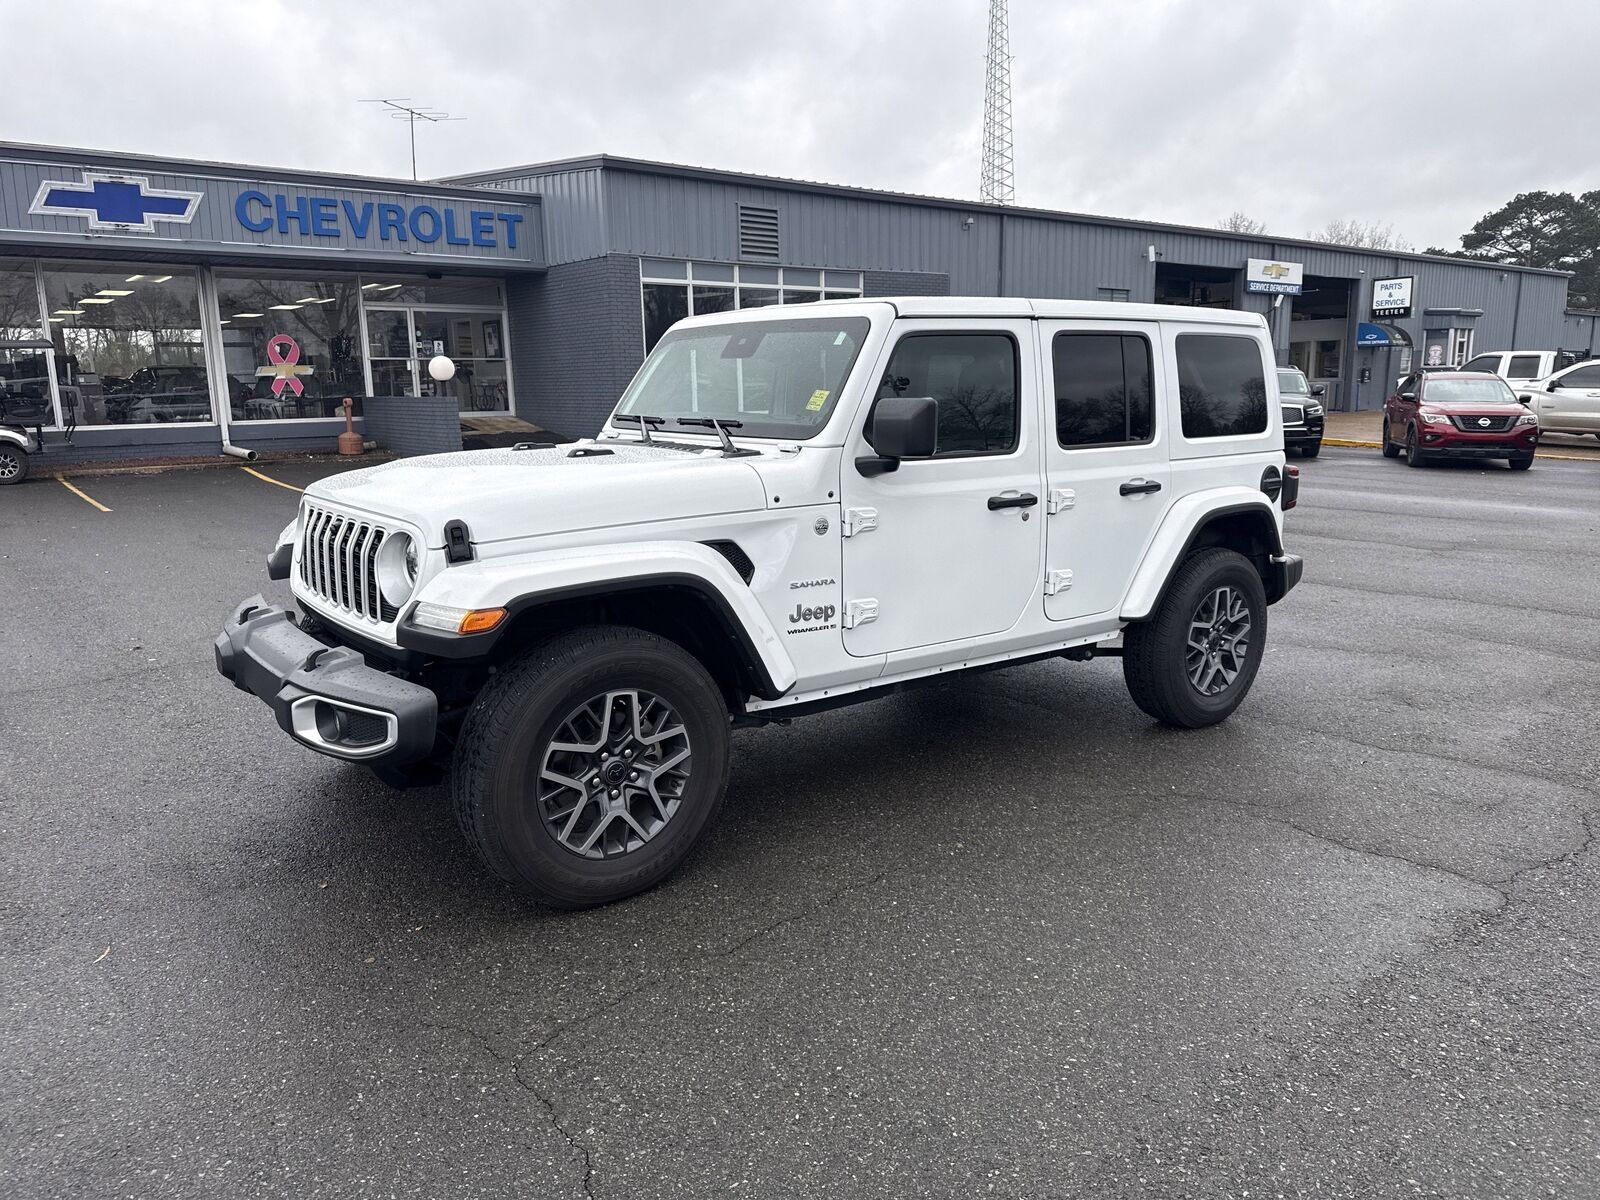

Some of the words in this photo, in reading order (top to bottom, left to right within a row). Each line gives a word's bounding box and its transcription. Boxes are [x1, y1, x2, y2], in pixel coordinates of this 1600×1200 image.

[235, 190, 524, 249] CHEVROLET
[1250, 282, 1269, 292] SERVICE
[1270, 283, 1300, 293] DEPARTMENT
[1380, 282, 1403, 291] PARTS
[1375, 298, 1406, 307] SERVICE
[1375, 308, 1405, 316] TEETER
[790, 578, 836, 589] SAHARA
[789, 604, 835, 623] Jeep
[787, 625, 829, 635] WRANGLER
